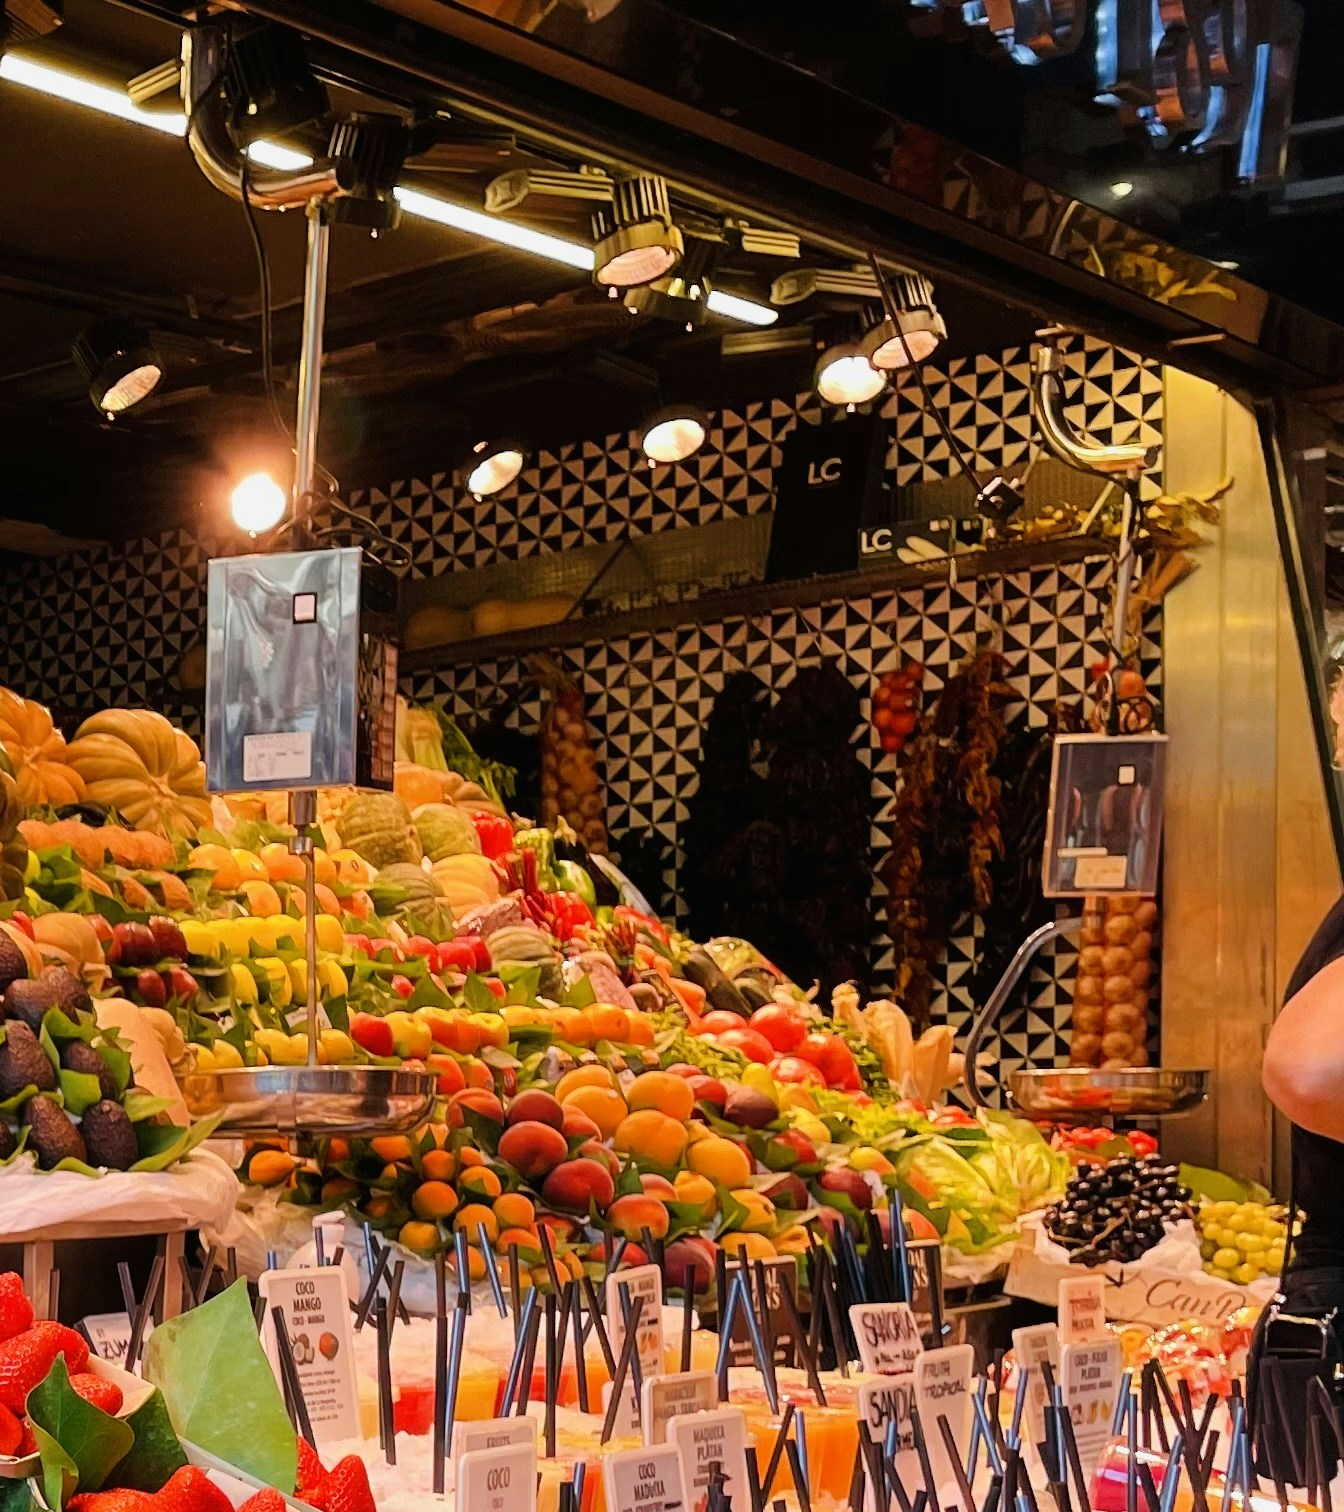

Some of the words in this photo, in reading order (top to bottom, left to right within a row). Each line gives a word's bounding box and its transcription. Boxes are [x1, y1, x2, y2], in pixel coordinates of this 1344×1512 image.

[808, 457, 842, 485] LC
[861, 528, 893, 555] LC
[295, 1282, 315, 1295] COCO
[293, 1297, 322, 1312] MANGO
[487, 1466, 511, 1491] COCO
[638, 1462, 656, 1480] COCO
